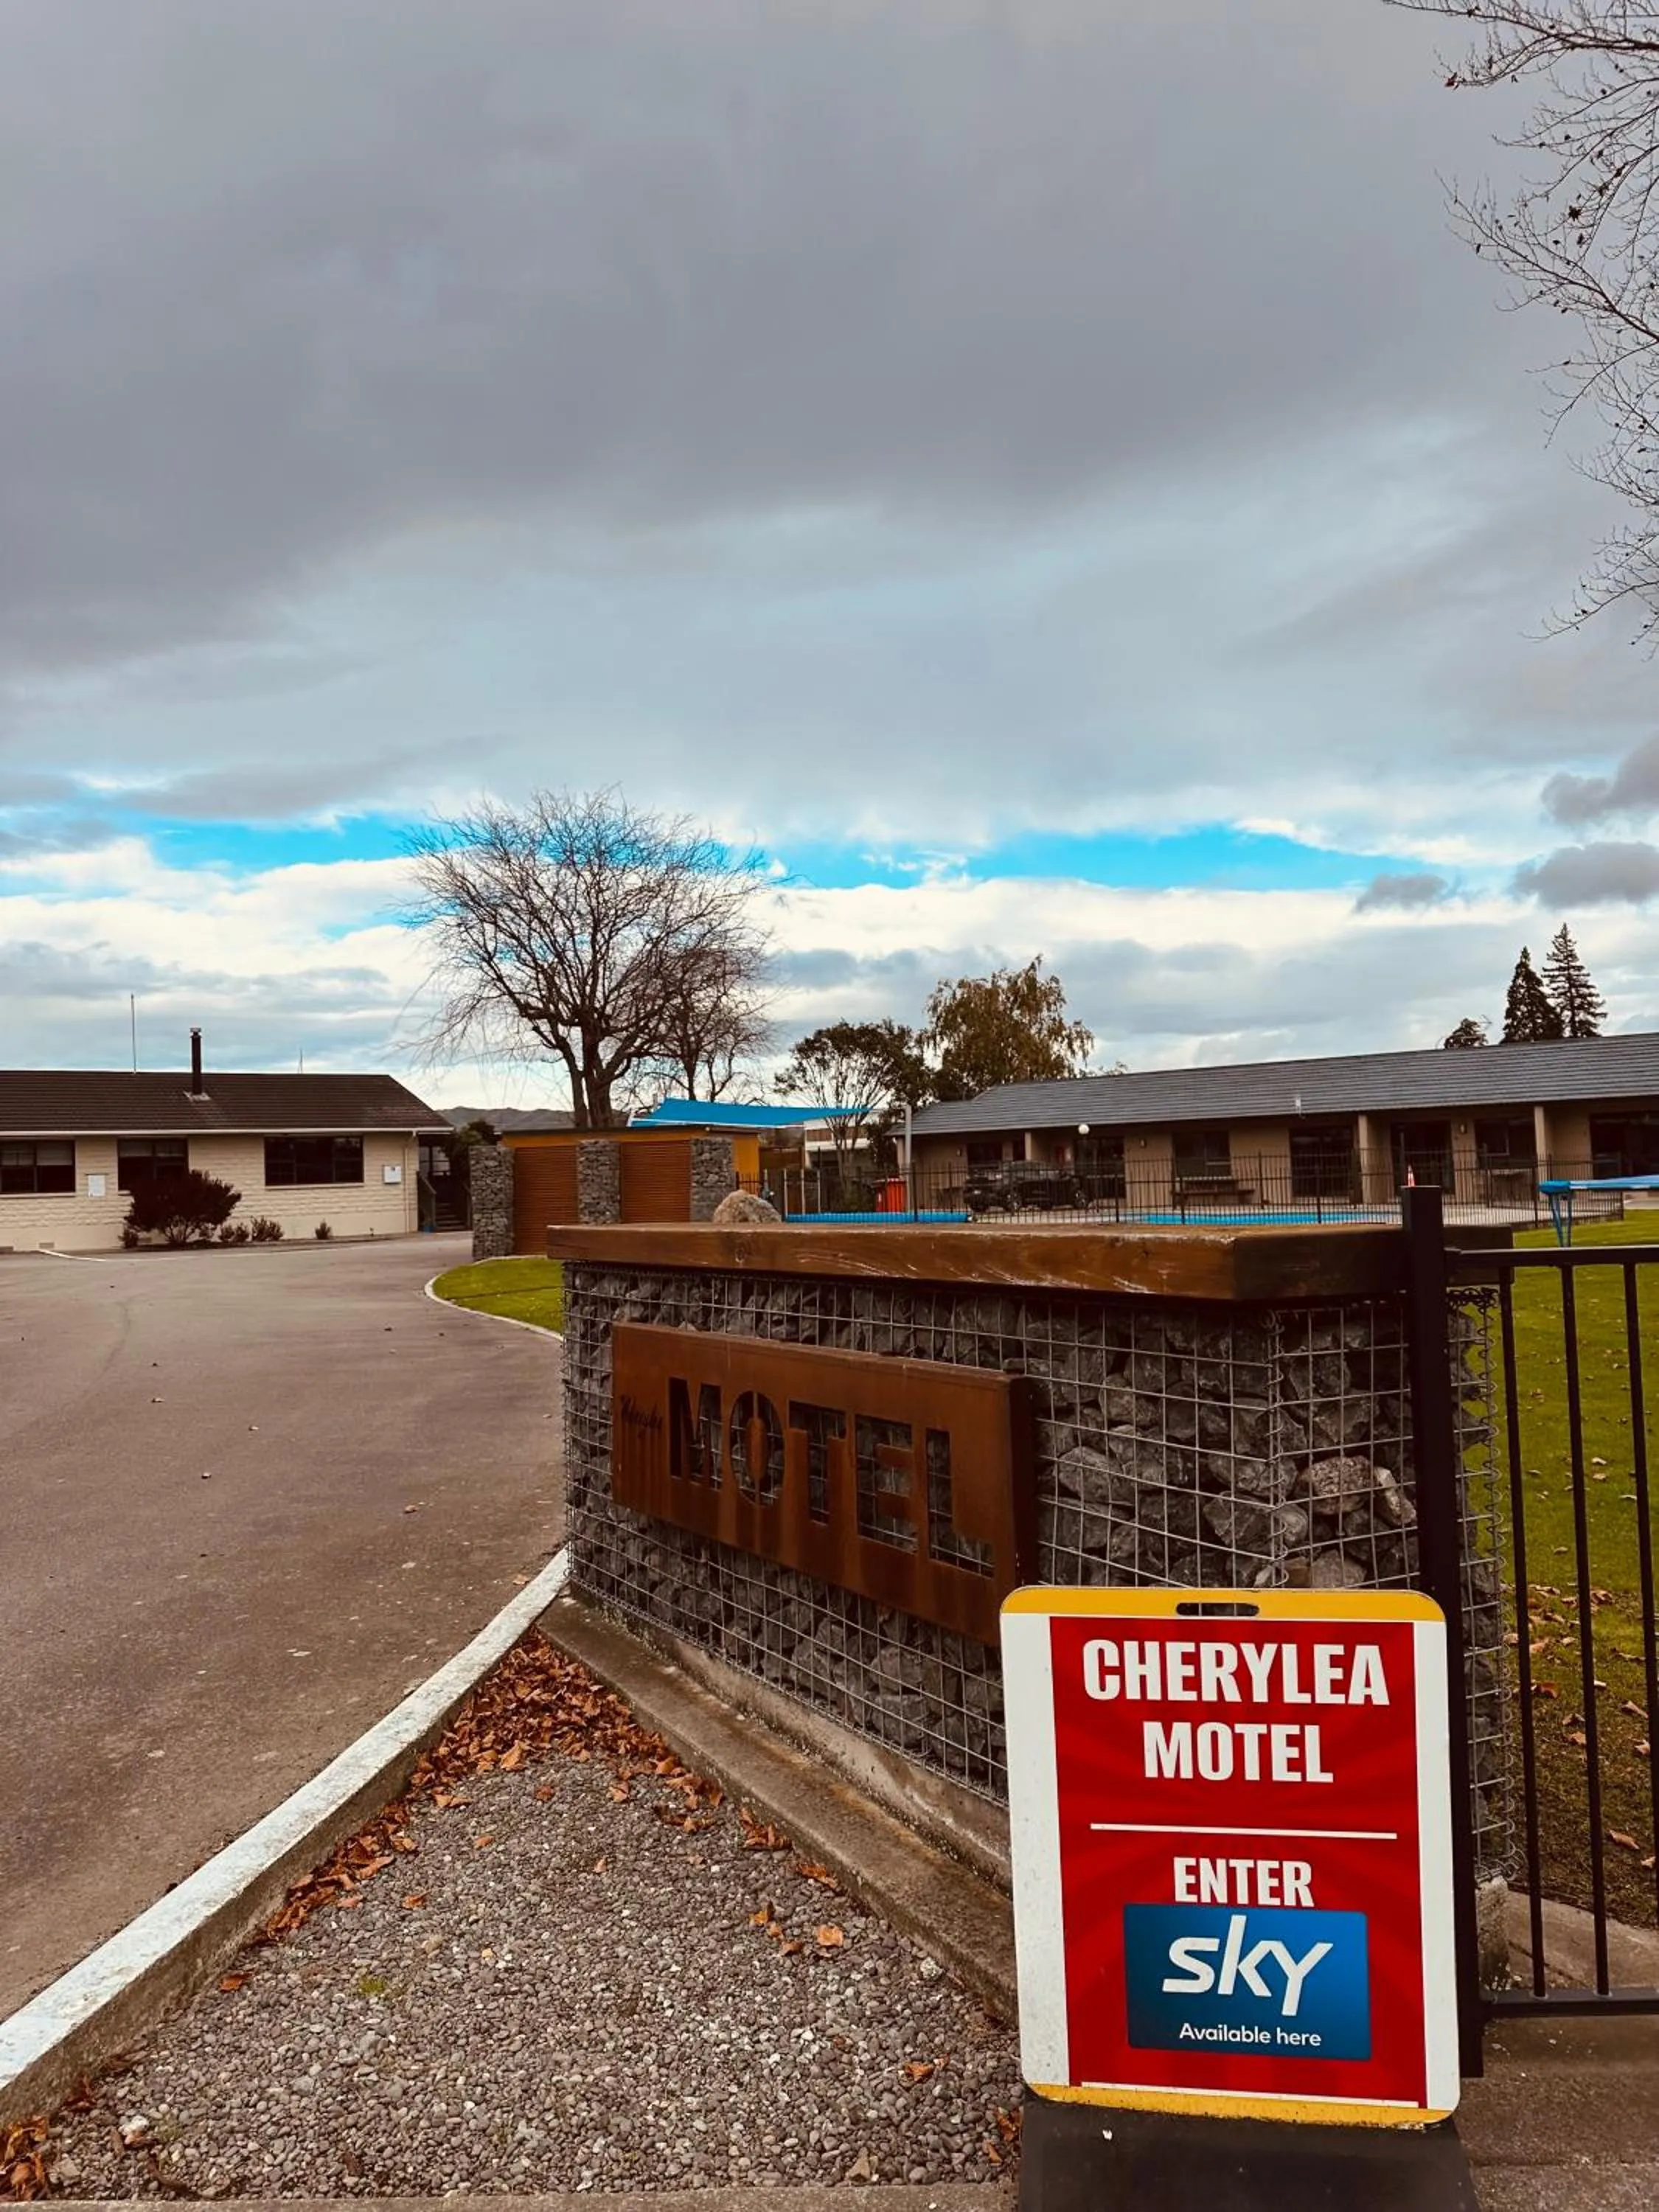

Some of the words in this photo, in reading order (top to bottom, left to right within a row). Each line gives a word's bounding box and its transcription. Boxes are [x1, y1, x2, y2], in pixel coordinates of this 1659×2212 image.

[668, 1377, 995, 1579] MOTEL
[1083, 1640, 1389, 1705] CHERYLEA
[1144, 1722, 1333, 1782] MOTEL
[1174, 1857, 1314, 1907] ENTER
[1163, 1915, 1332, 2016] sky
[1180, 2023, 1270, 2044] Available
[1277, 2028, 1321, 2046] here
